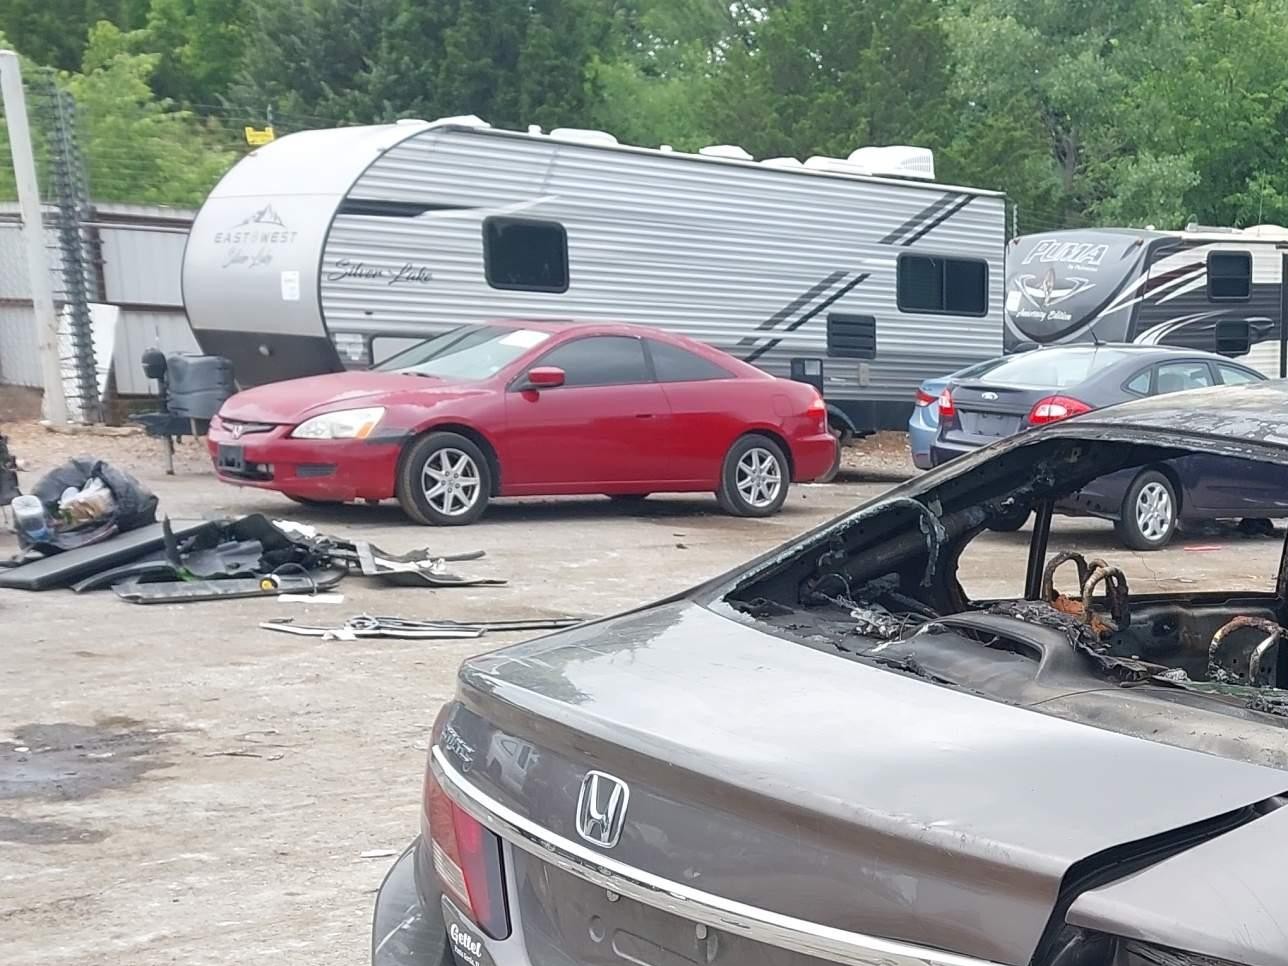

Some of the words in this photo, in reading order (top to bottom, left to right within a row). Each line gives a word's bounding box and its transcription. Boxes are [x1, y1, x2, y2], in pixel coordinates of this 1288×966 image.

[1021, 239, 1109, 265] PUMA
[327, 258, 383, 281] Silver
[388, 261, 433, 286] Lake
